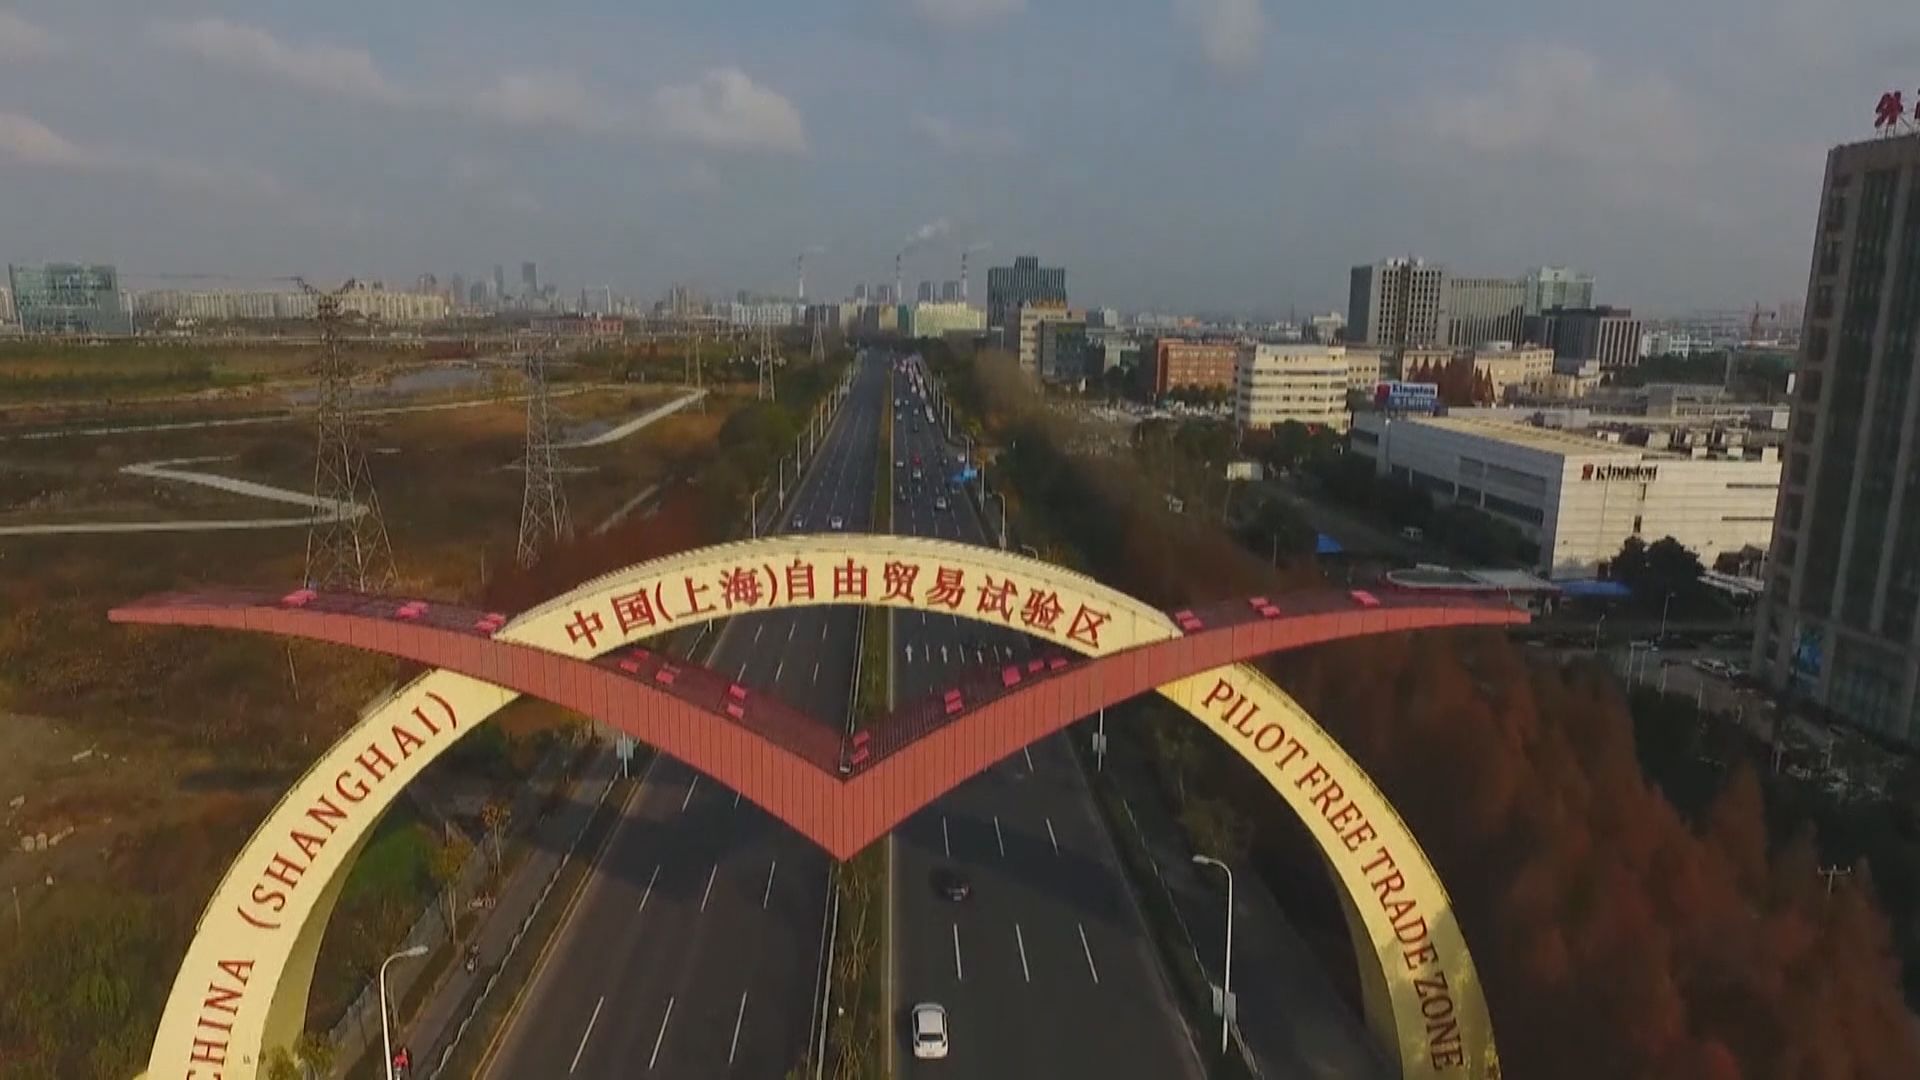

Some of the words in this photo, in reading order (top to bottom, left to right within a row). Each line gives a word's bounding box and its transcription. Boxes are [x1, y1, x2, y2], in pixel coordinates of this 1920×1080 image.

[1874, 90, 1920, 127] 外
[1596, 463, 1658, 481] Kingston
[565, 557, 1111, 649] 中国(上海)自由贸易试验区
[237, 690, 458, 930] (SHANGHAI)
[1201, 678, 1308, 772] PILOT
[1294, 762, 1377, 852] FREE
[1361, 846, 1439, 970] TRADE
[1414, 971, 1465, 1071] ZONE
